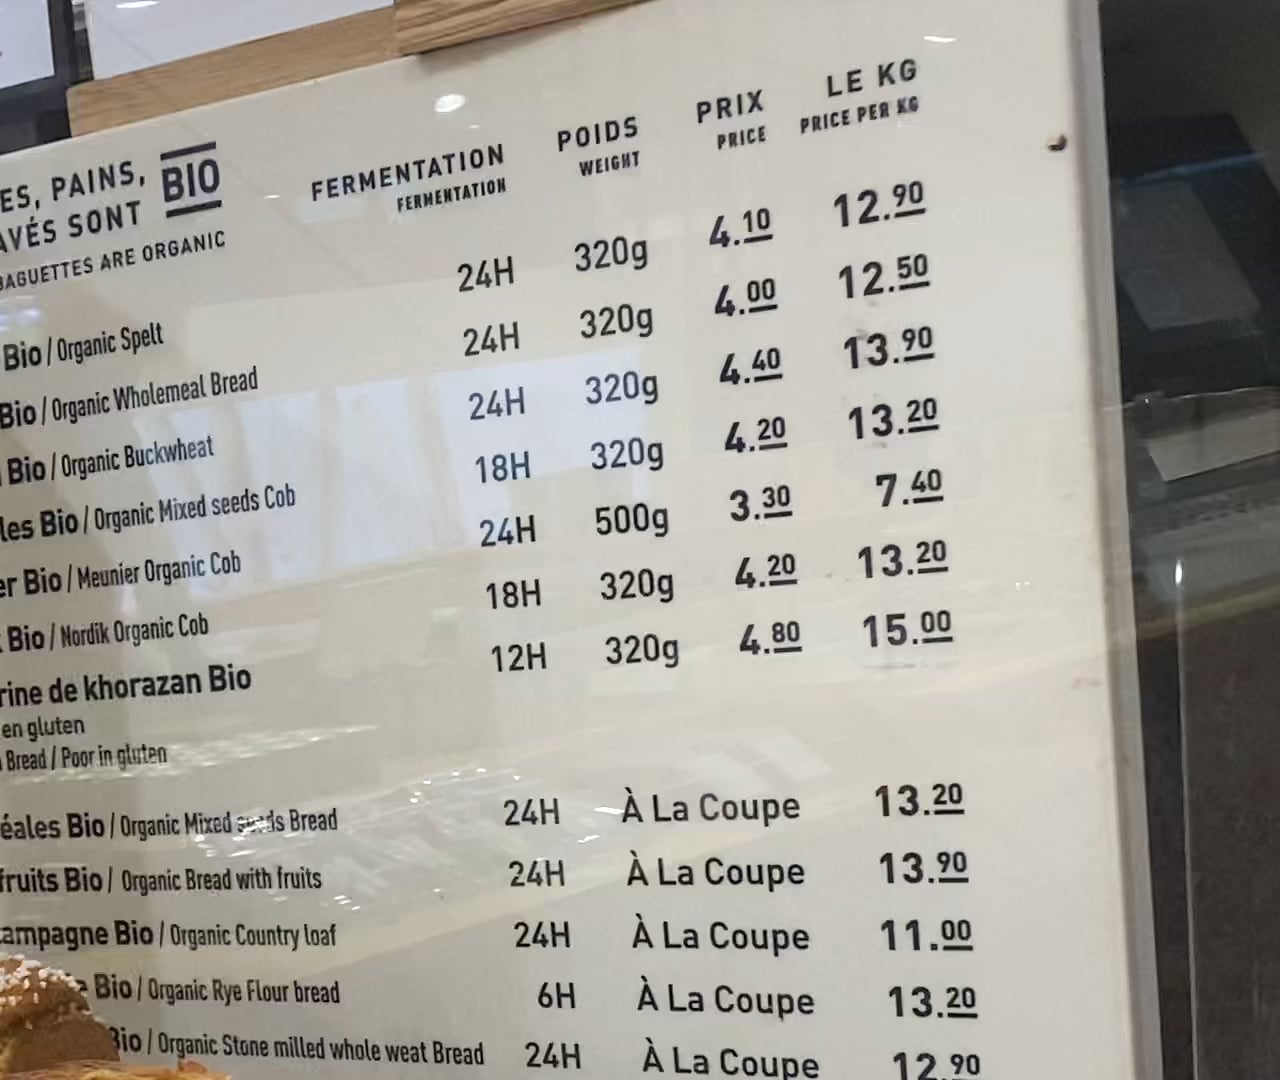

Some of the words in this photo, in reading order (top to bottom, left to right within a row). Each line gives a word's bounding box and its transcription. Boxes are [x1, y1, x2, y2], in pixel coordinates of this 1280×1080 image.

[827, 69, 863, 97] LE
[878, 59, 916, 87] KG
[697, 89, 763, 124] PRIX
[800, 109, 850, 134] PRICE
[857, 102, 889, 123] PER
[897, 96, 919, 114] KG
[558, 116, 637, 152] POIDS
[718, 126, 766, 150] PRICE
[52, 161, 144, 201] PAINS,
[162, 159, 219, 202] BIO
[312, 144, 503, 201] FERMENTATION
[579, 151, 639, 176] WEIGHT
[397, 178, 506, 212] FERMENTATION
[68, 200, 140, 237] SONT
[457, 256, 514, 292] 24H
[575, 236, 647, 271] 320g
[710, 208, 773, 247] 4.10
[834, 181, 926, 227] 12.90
[101, 248, 136, 270] ARE
[142, 231, 225, 261] ORGANIC
[464, 322, 519, 356] 24H
[580, 304, 652, 338] 320g
[715, 278, 778, 316] 4.00
[839, 254, 930, 298] 12.50
[3, 341, 42, 371] Bio
[57, 331, 116, 364] Organic
[121, 322, 163, 355] Spelt
[469, 387, 524, 420] 24H
[586, 371, 658, 404] 320g
[720, 348, 783, 385] 4.40
[844, 326, 935, 369] 13.90
[7, 456, 46, 485] Bio
[62, 449, 120, 480] Organic
[124, 436, 214, 468] Buckwheat
[476, 451, 530, 483] 18H
[591, 438, 663, 471] 320g
[725, 417, 788, 453] 4.20
[849, 398, 939, 439] 13.20
[40, 508, 78, 537] Bio
[95, 502, 155, 533] Organic
[159, 494, 207, 523] Mixed
[211, 488, 259, 515] seeds
[265, 483, 295, 509] Cob
[480, 515, 536, 547] 24H
[596, 503, 668, 537] 500g
[730, 485, 793, 521] 3.30
[876, 469, 944, 507] 7.40
[23, 567, 62, 595] Bio
[77, 562, 140, 589] Meunier
[144, 555, 205, 586] Organic
[210, 550, 241, 575] Cob
[492, 642, 546, 672] 12H
[606, 634, 678, 668] 320g
[740, 621, 802, 655] 4.80
[863, 610, 953, 647] 15.00
[49, 677, 78, 703] de
[84, 673, 202, 701] khorazan
[208, 663, 251, 692] Bio
[2, 723, 23, 739] en
[27, 716, 85, 742] gluten
[6, 748, 47, 771] Bread
[61, 747, 95, 768] Poor
[98, 745, 113, 767] in
[117, 743, 167, 771] gluten
[66, 813, 105, 838] Bio
[121, 813, 180, 841] Organic
[185, 811, 232, 838] Mixed
[289, 808, 337, 831] Bread
[504, 798, 559, 826] 24H
[622, 787, 643, 823] À
[653, 795, 688, 822] La
[700, 793, 800, 827] Coupe
[876, 783, 965, 816] 13.20
[114, 920, 153, 945] Bio
[170, 924, 231, 951] Organic
[236, 924, 299, 951] Country
[304, 924, 336, 946] loaf
[94, 974, 132, 1000] Bio
[148, 978, 208, 1006] Organic
[212, 979, 242, 1006] Rye
[247, 979, 289, 1002] Flour
[294, 980, 340, 1003] bread
[538, 982, 575, 1008] 6H
[637, 975, 658, 1011] À
[668, 984, 704, 1012] La
[715, 985, 814, 1021] Coupe
[889, 986, 978, 1019] 13.20
[158, 1032, 218, 1059] Organic
[222, 1034, 269, 1057] Stone
[274, 1036, 325, 1059] milled
[329, 1038, 381, 1061] whole
[385, 1042, 428, 1063] weat
[433, 1041, 484, 1065] Bread
